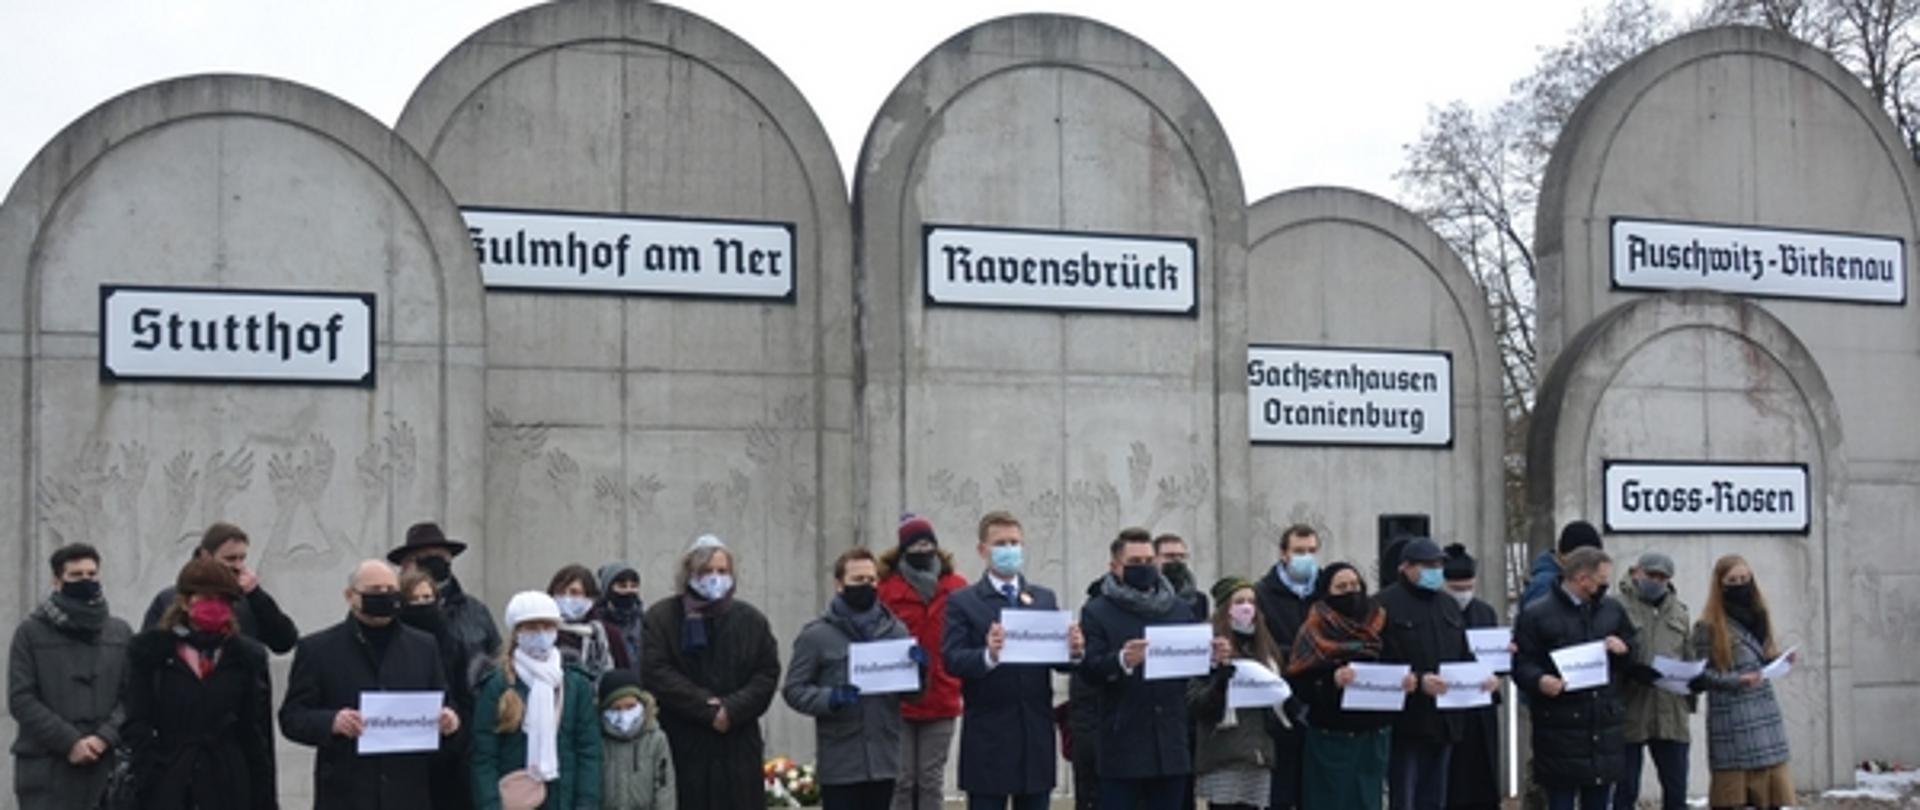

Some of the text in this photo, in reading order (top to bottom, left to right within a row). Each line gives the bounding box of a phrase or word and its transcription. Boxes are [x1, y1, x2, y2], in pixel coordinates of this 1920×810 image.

[644, 243, 701, 272] am
[713, 238, 783, 276] Ner
[941, 244, 1179, 291] Ravensbrück
[131, 307, 344, 363] Stutthof
[1248, 359, 1437, 394] Sachsenhausen
[1264, 398, 1424, 434] Oranienburg
[1621, 478, 1794, 513] Gross-Rosen
